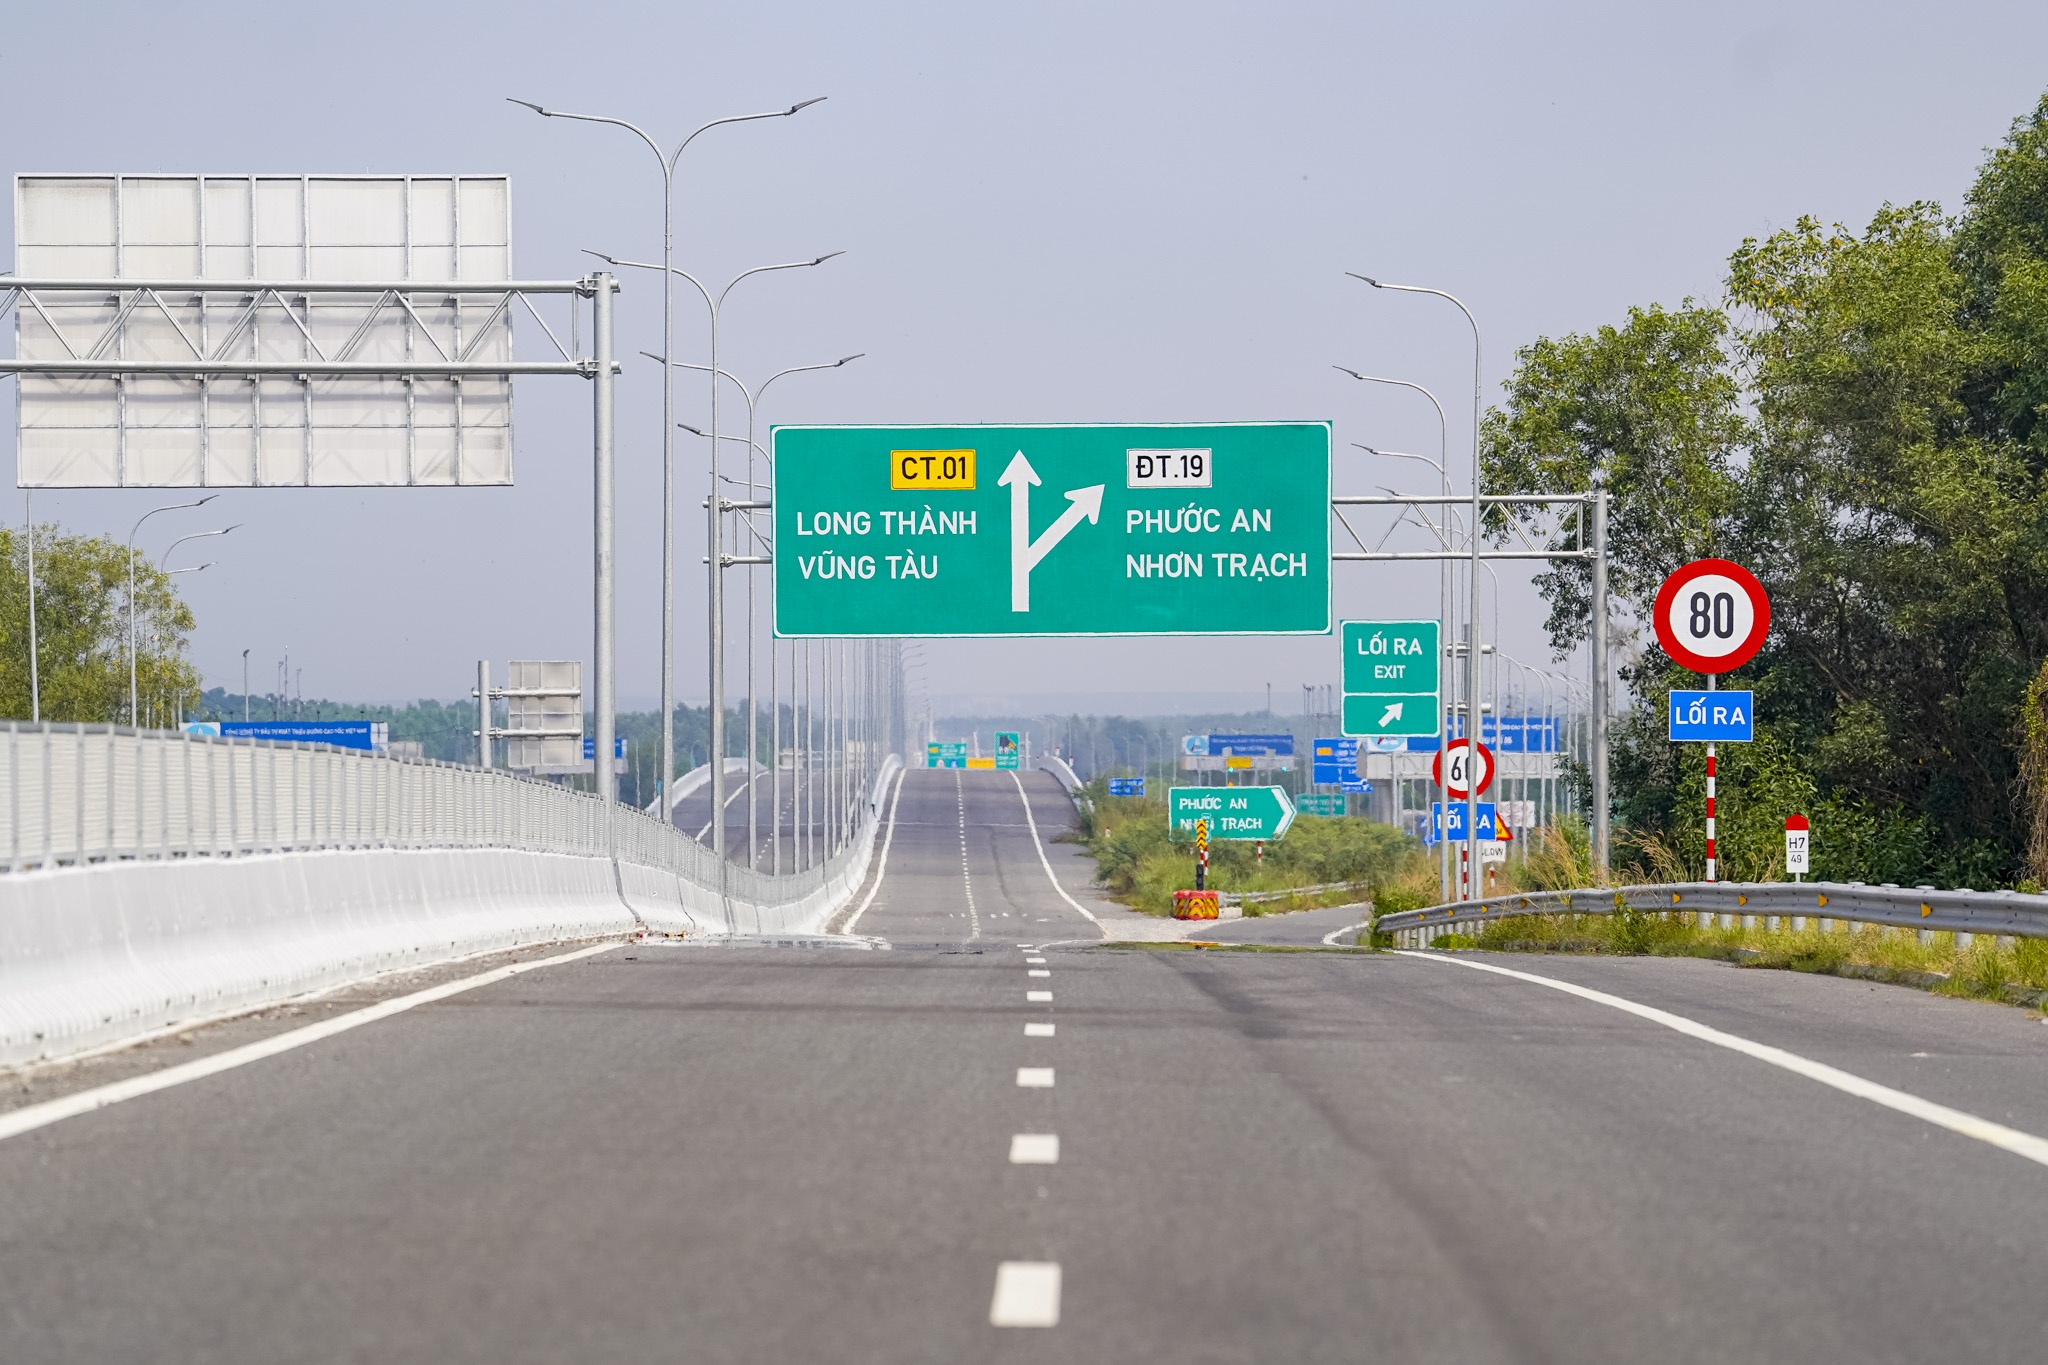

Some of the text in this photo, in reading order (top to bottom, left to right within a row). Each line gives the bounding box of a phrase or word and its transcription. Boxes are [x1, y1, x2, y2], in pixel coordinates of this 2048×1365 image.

[901, 456, 966, 480] CT.01
[1135, 454, 1203, 478] ĐT.19
[796, 504, 977, 535] LONG THÀNH
[1126, 502, 1271, 533] PHƯỚC AN
[798, 548, 938, 579] VŨNG TÀU
[1126, 551, 1307, 582] NHƠN TRẠCH
[1690, 592, 1734, 638] 80
[1357, 631, 1423, 655] LỐI RA
[1374, 665, 1406, 679] EXIT
[1675, 697, 1746, 725] LỐI RA
[1179, 794, 1248, 810] PHƯỚC AN
[1220, 817, 1262, 832] TRẠCH
[1788, 837, 1805, 849] H7
[1790, 854, 1802, 864] 49
